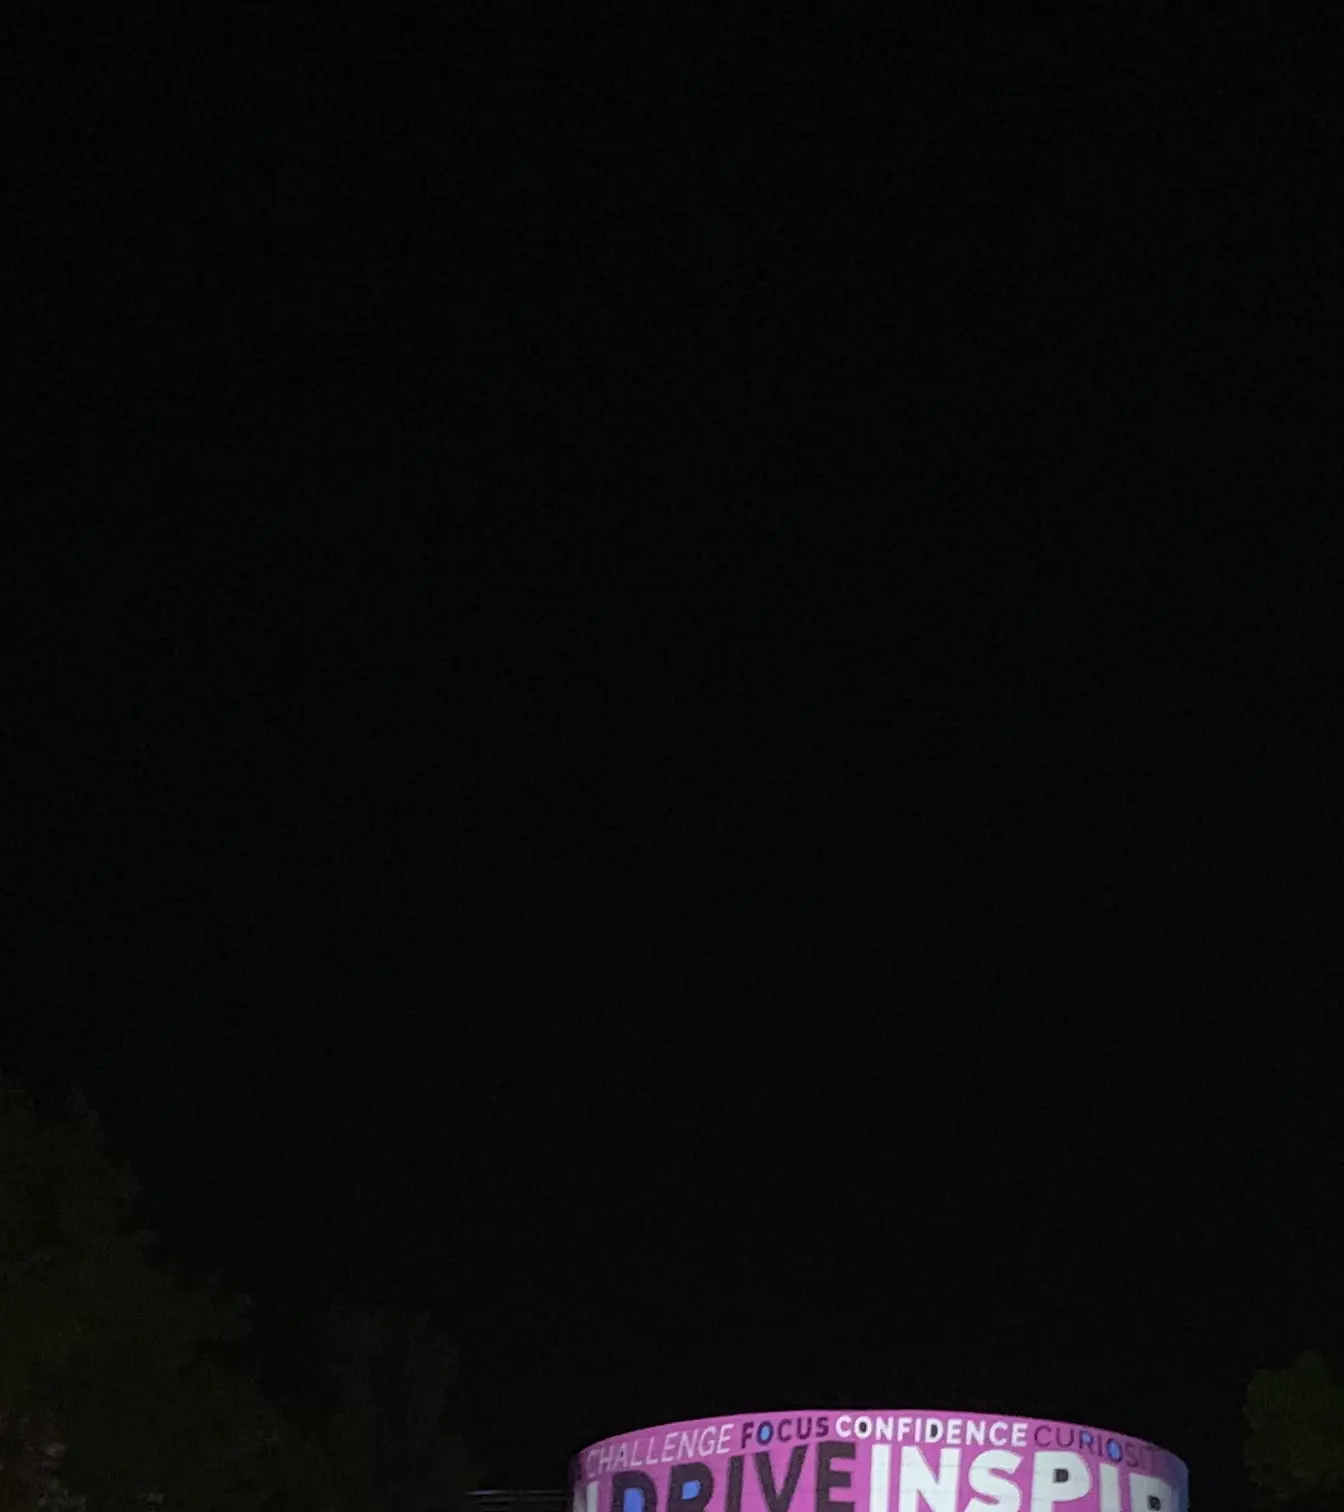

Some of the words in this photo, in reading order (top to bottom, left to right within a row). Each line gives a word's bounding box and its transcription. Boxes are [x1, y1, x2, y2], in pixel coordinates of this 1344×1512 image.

[587, 1423, 734, 1477] CHALLENGE
[741, 1416, 829, 1449] FOCUS
[835, 1415, 1029, 1447] CONFIDENCE
